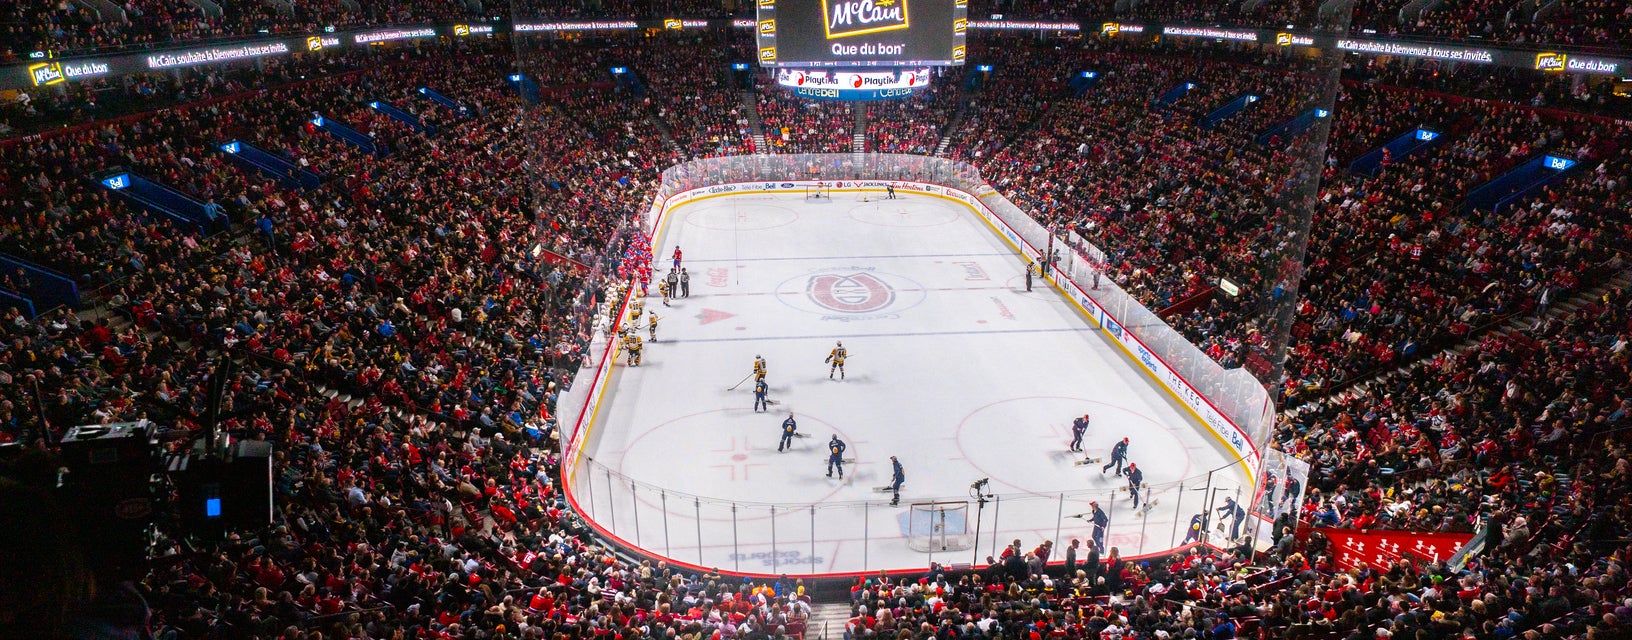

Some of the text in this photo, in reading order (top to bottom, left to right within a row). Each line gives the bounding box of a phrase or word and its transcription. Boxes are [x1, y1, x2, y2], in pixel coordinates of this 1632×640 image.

[830, 0, 904, 28] McCain
[148, 43, 288, 68] McCain souhaite la bienvenue à tous ses invités.
[832, 43, 857, 55] Que
[860, 43, 876, 54] du
[1337, 40, 1492, 62] McCain souhaite la bienvenue à tous ses invités.
[65, 66, 82, 77] Que
[83, 64, 92, 74] du
[1569, 59, 1586, 69] Que
[1586, 60, 1597, 70] du
[35, 67, 61, 83] McCain
[1421, 131, 1432, 140] Bell
[1551, 158, 1566, 169] Bell
[109, 176, 123, 189] Bell
[901, 182, 923, 191] Hortons
[1168, 371, 1182, 389] THE
[1185, 386, 1200, 406] KEG
[1232, 431, 1244, 452] Bell
